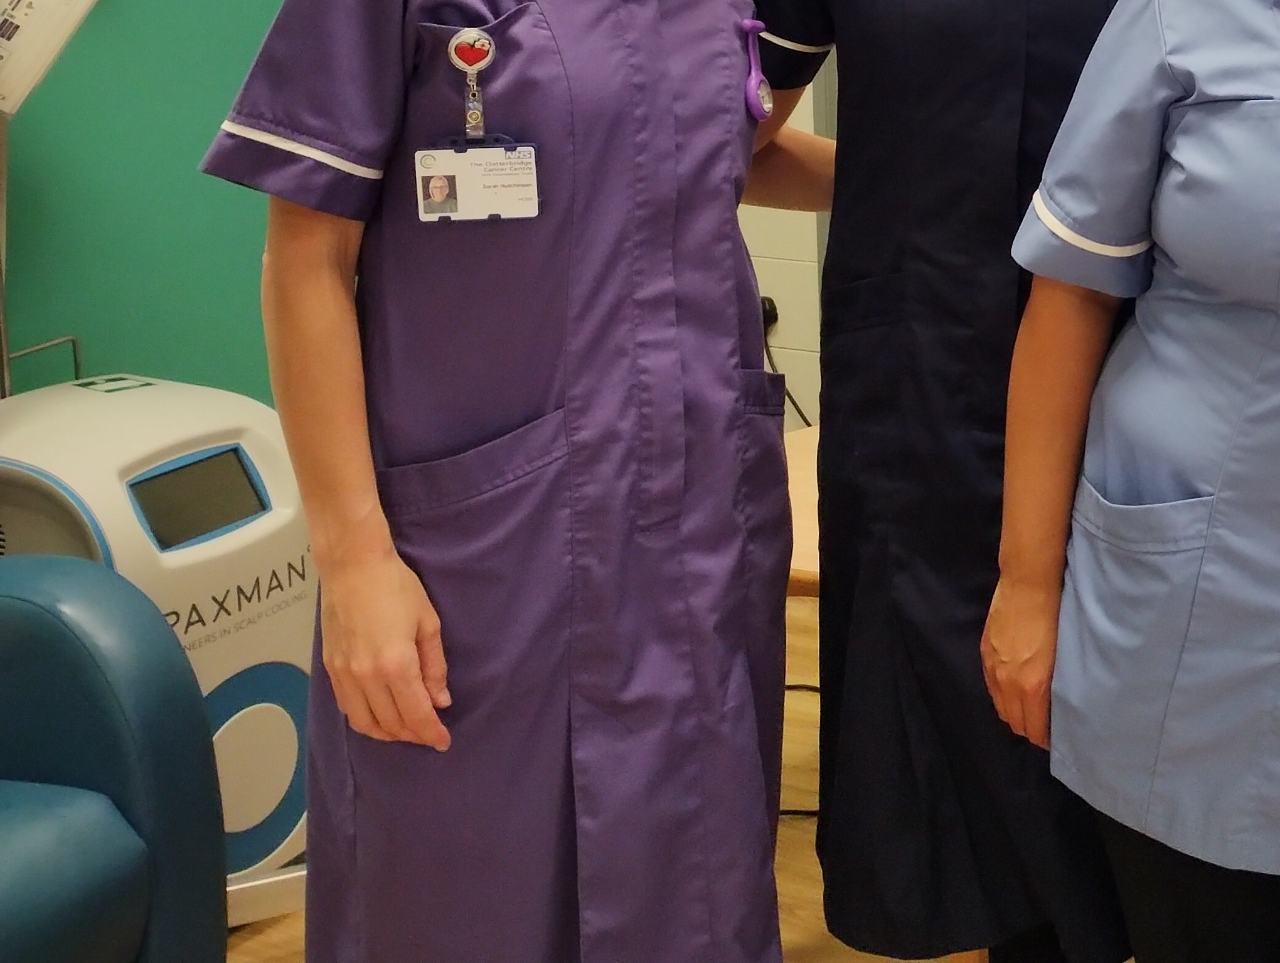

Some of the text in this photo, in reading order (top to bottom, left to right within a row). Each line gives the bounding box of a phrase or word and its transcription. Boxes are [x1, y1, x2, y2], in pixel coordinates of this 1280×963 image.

[505, 151, 532, 160] NHS
[163, 554, 306, 635] PAXMAN
[183, 589, 307, 652] NEERS IN SCALP COOLING
